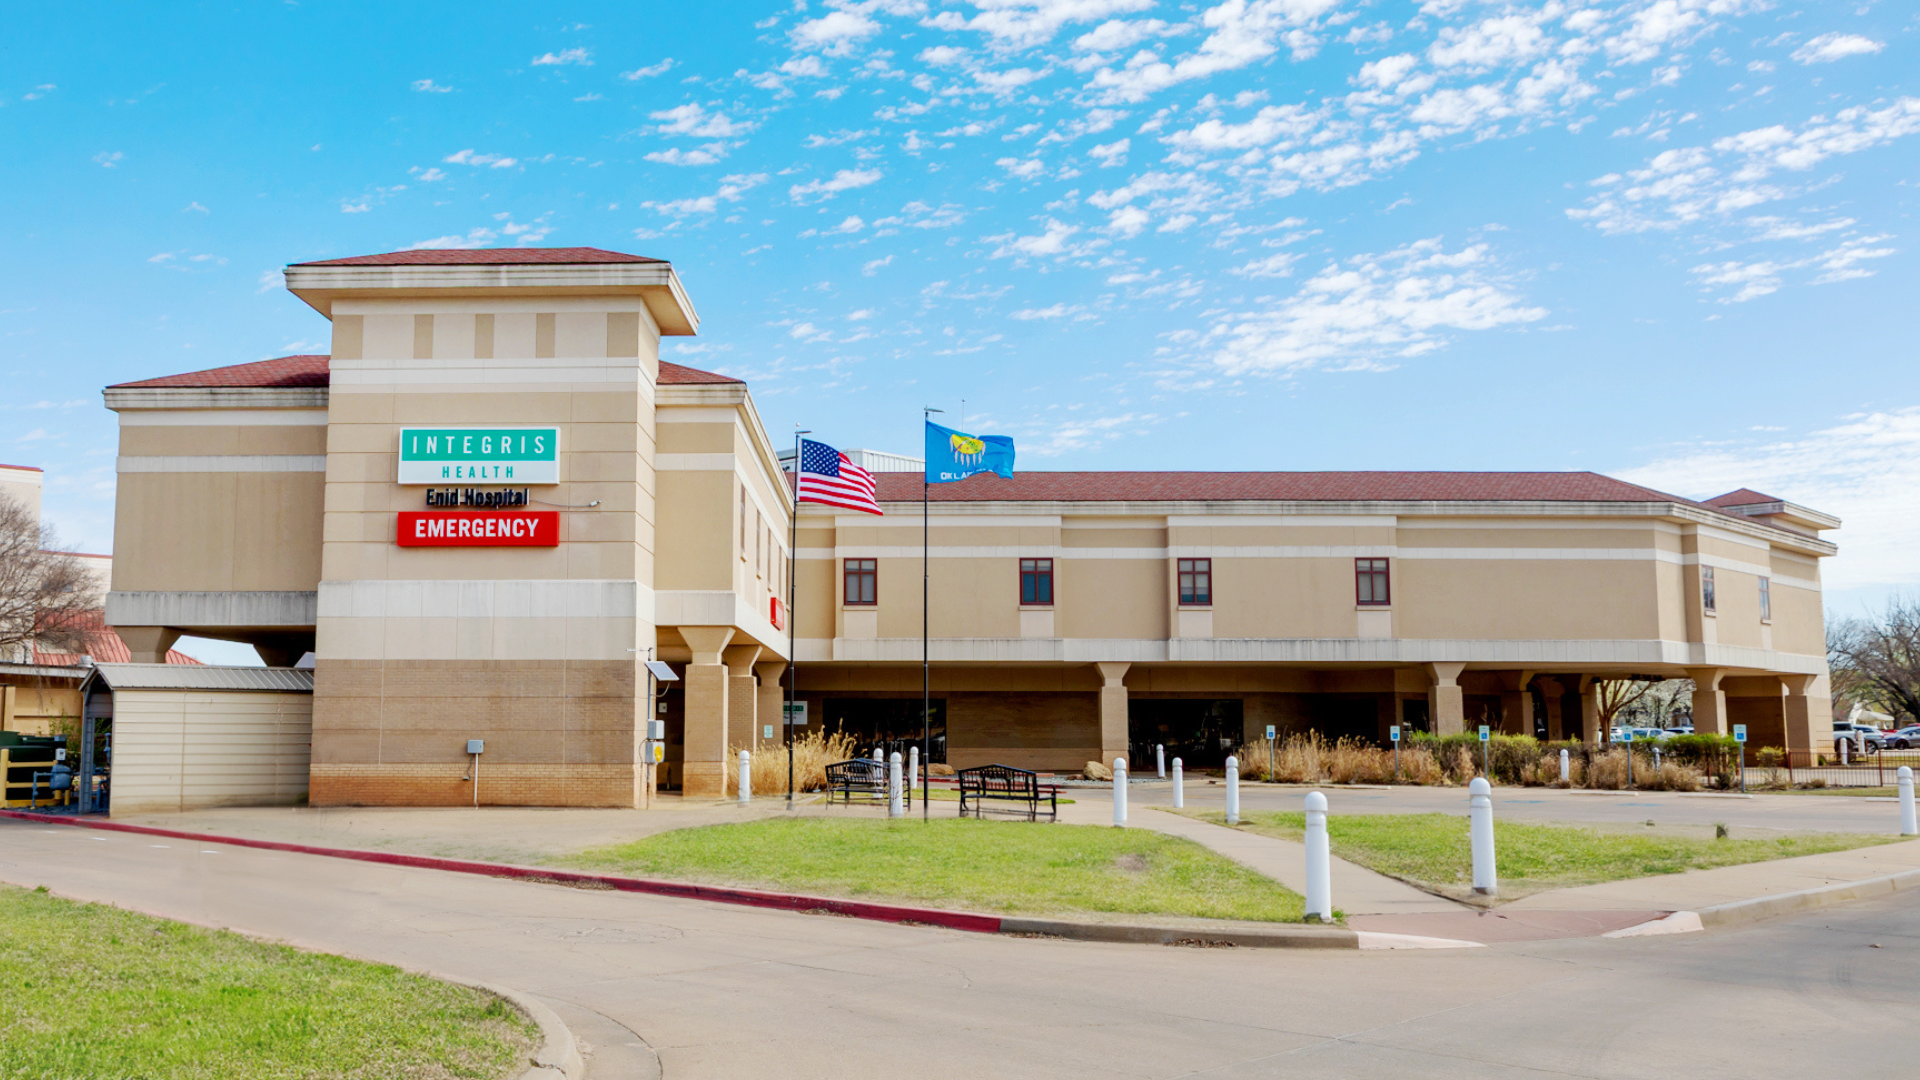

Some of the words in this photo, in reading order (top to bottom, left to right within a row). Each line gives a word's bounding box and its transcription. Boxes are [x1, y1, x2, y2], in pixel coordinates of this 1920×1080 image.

[412, 435, 545, 454] INTEGRIS
[442, 465, 514, 478] HEALTH
[940, 468, 994, 481] OKLA
[426, 488, 460, 506] Enid
[465, 488, 530, 509] Hospital
[415, 518, 539, 538] EMERGENCY
